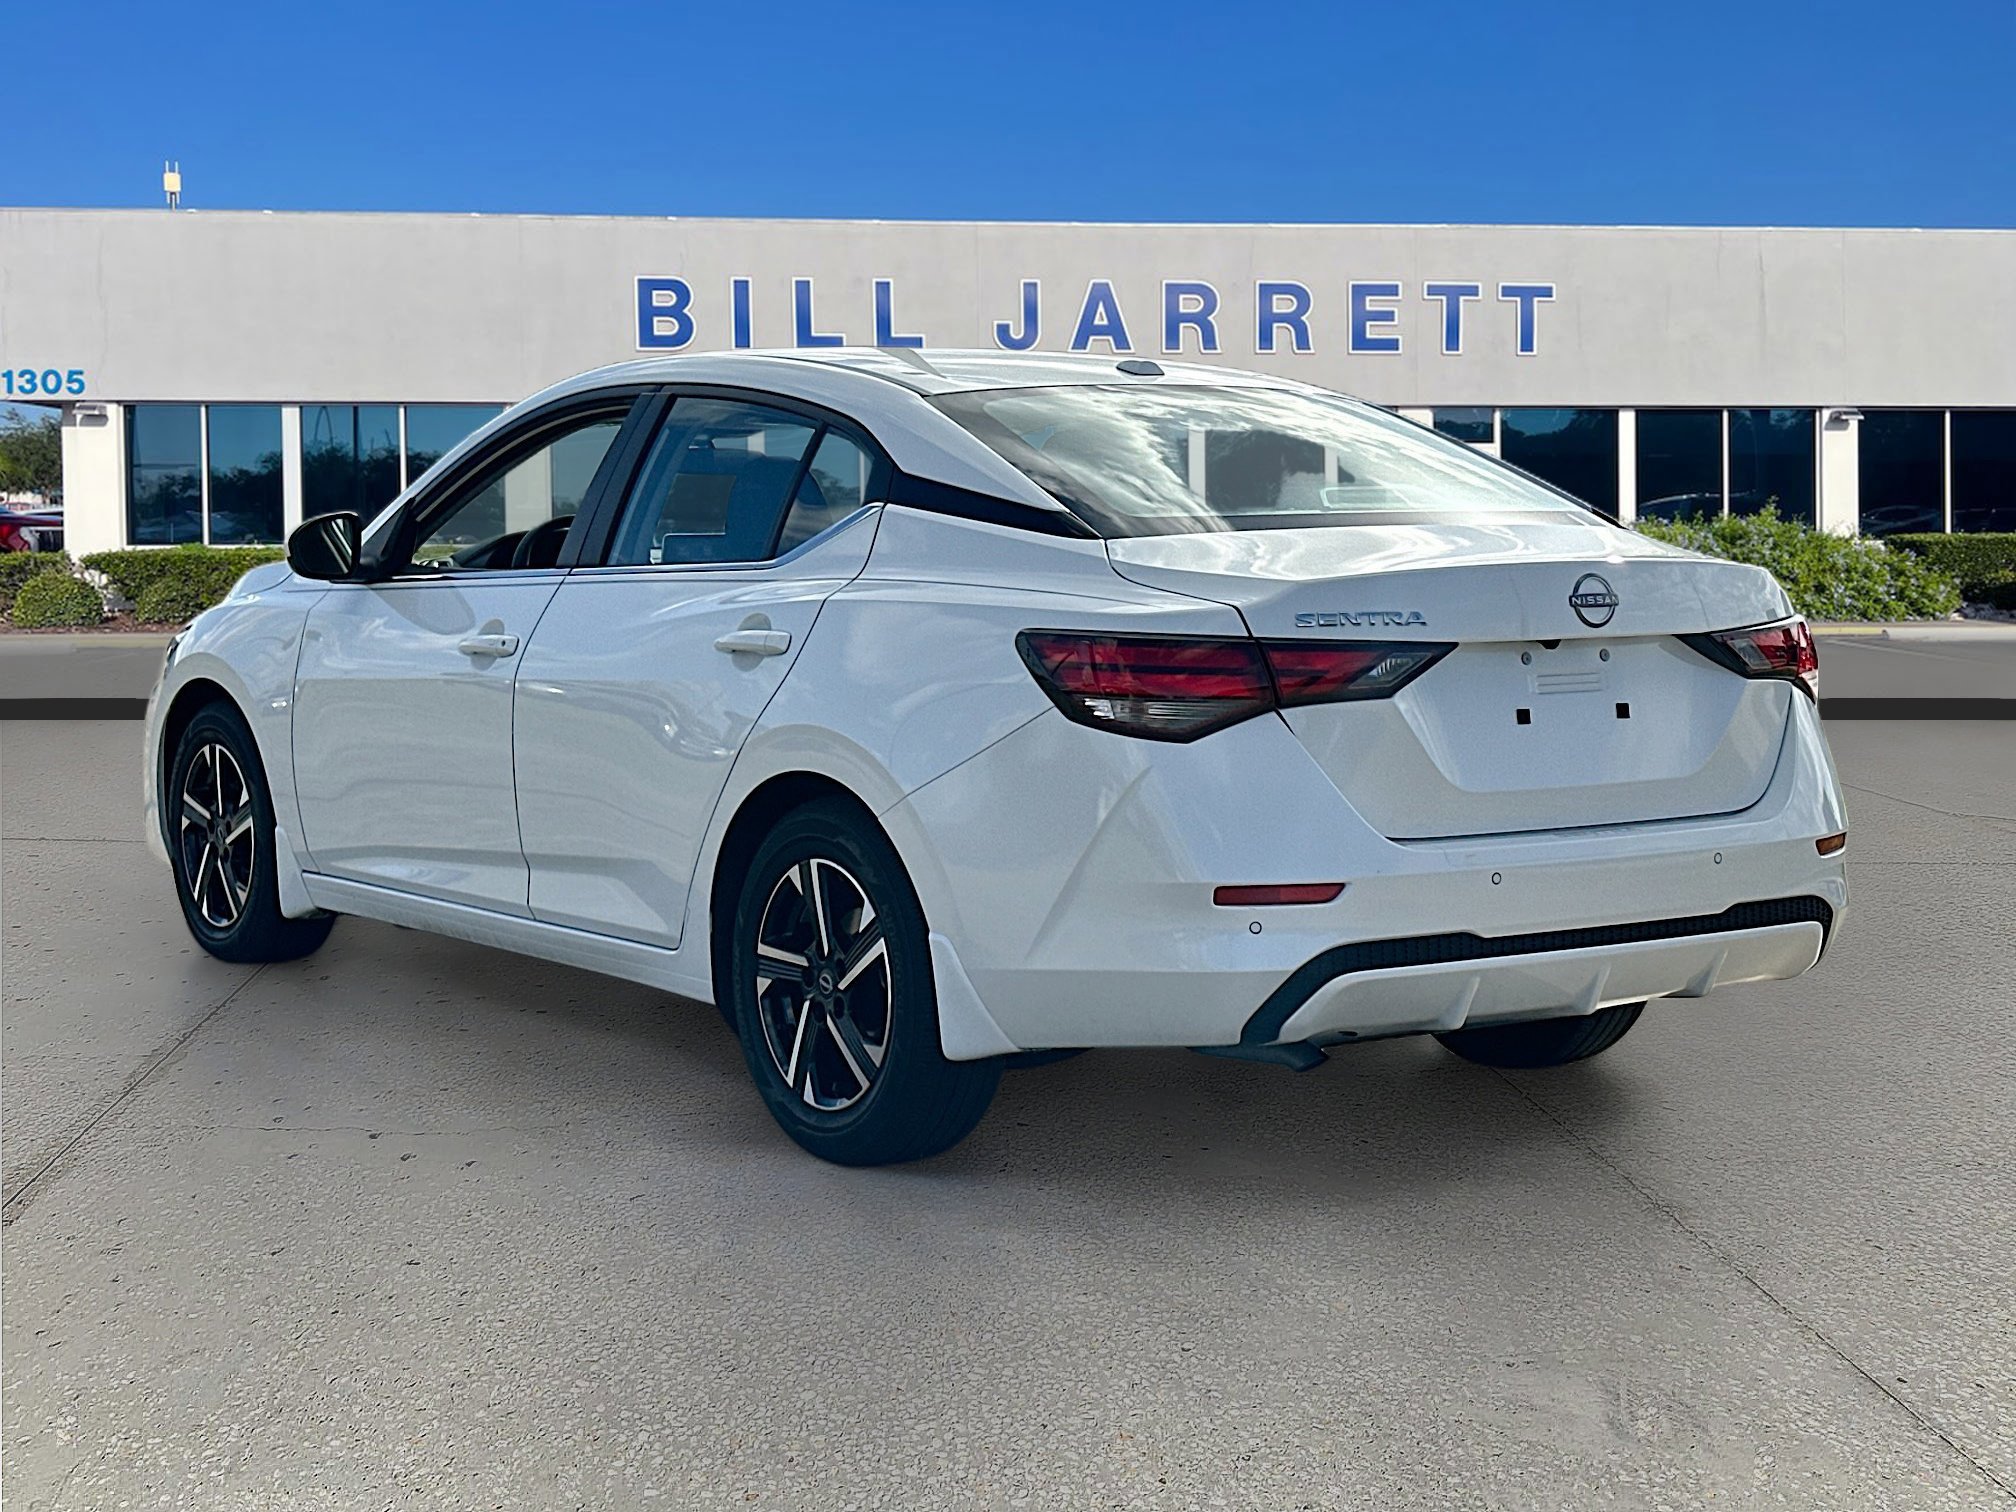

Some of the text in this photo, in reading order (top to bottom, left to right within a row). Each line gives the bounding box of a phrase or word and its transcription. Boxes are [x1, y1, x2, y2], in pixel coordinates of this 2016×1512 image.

[635, 275, 1557, 355] BILL JARRETT
[1, 368, 86, 395] 1305
[1572, 594, 1619, 607] NISSAN
[1295, 611, 1428, 628] SENTRA
